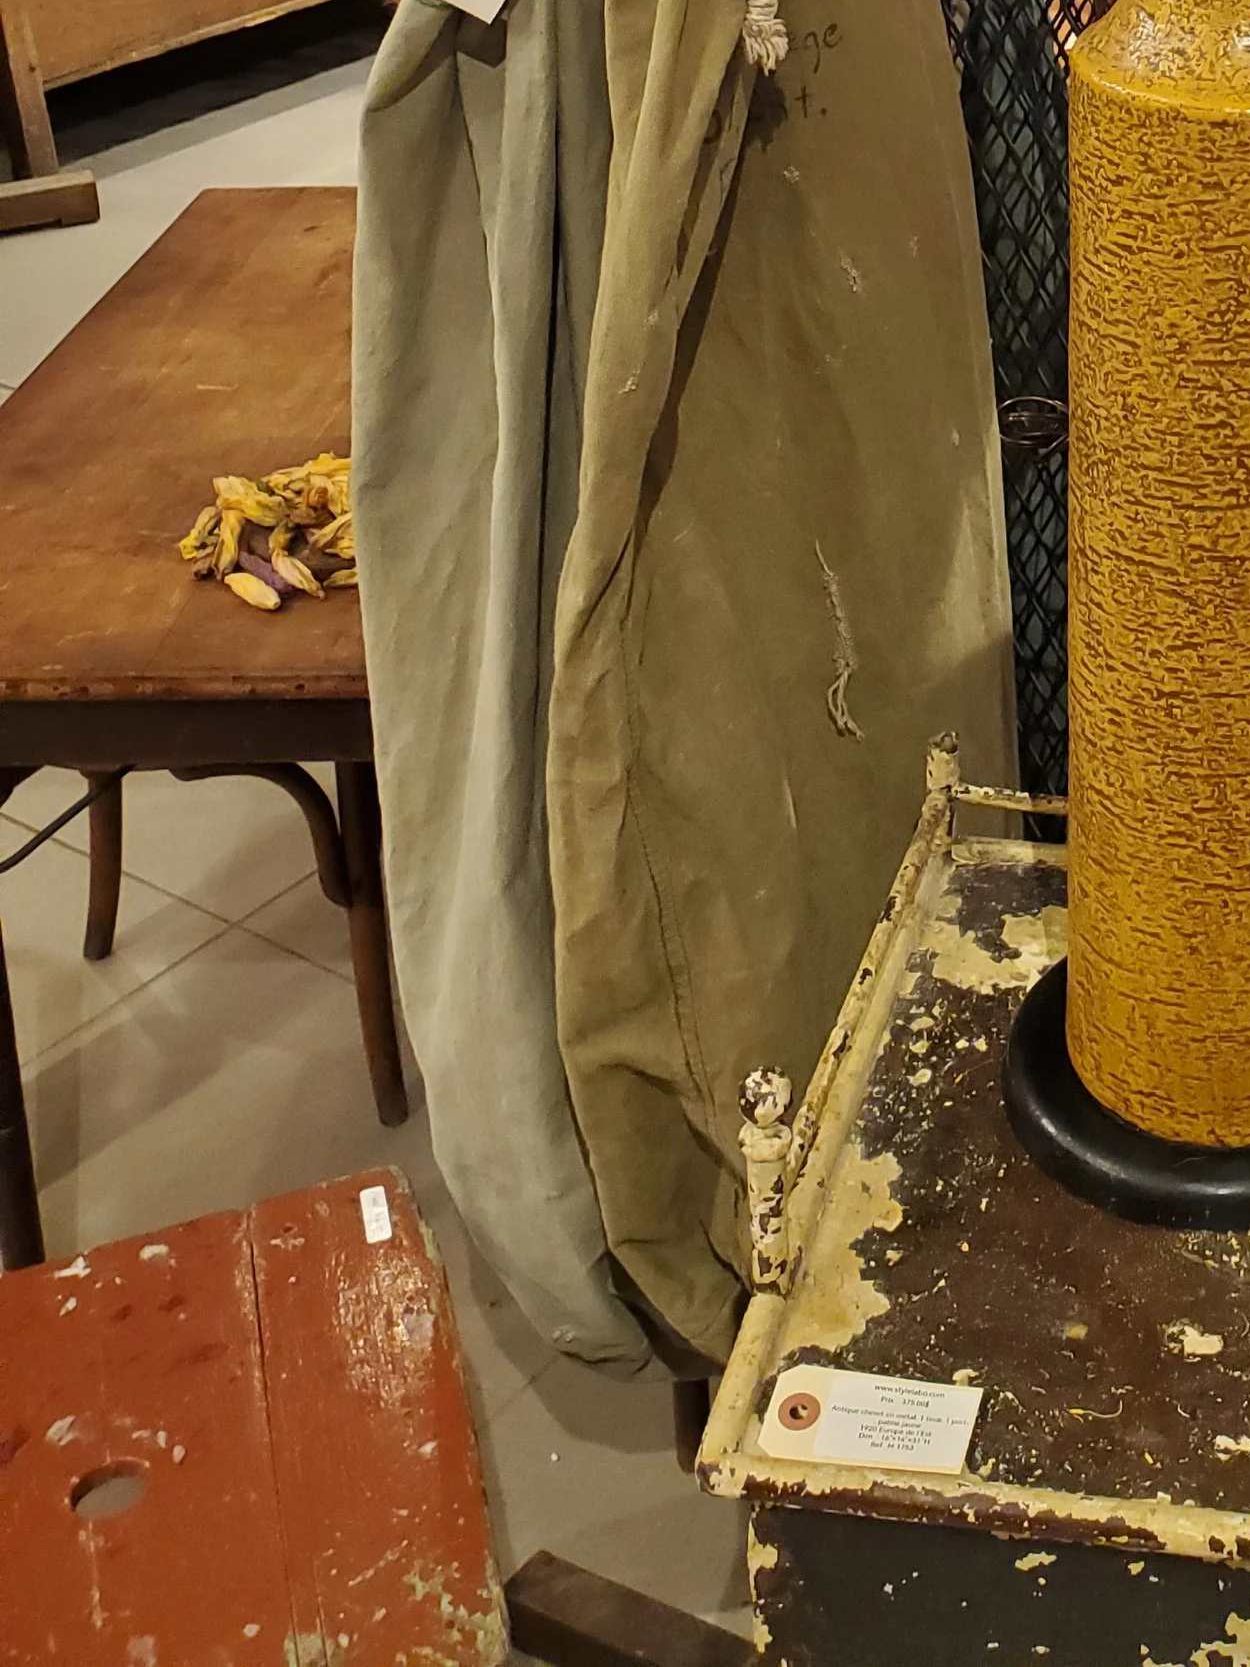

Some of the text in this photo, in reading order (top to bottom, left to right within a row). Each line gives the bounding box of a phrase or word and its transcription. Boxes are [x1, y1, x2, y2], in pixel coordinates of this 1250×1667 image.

[874, 1384, 945, 1398] www.stylelabo.com
[831, 1404, 859, 1414] Antique
[860, 1408, 883, 1417] chevet
[901, 1421, 922, 1430] jaune
